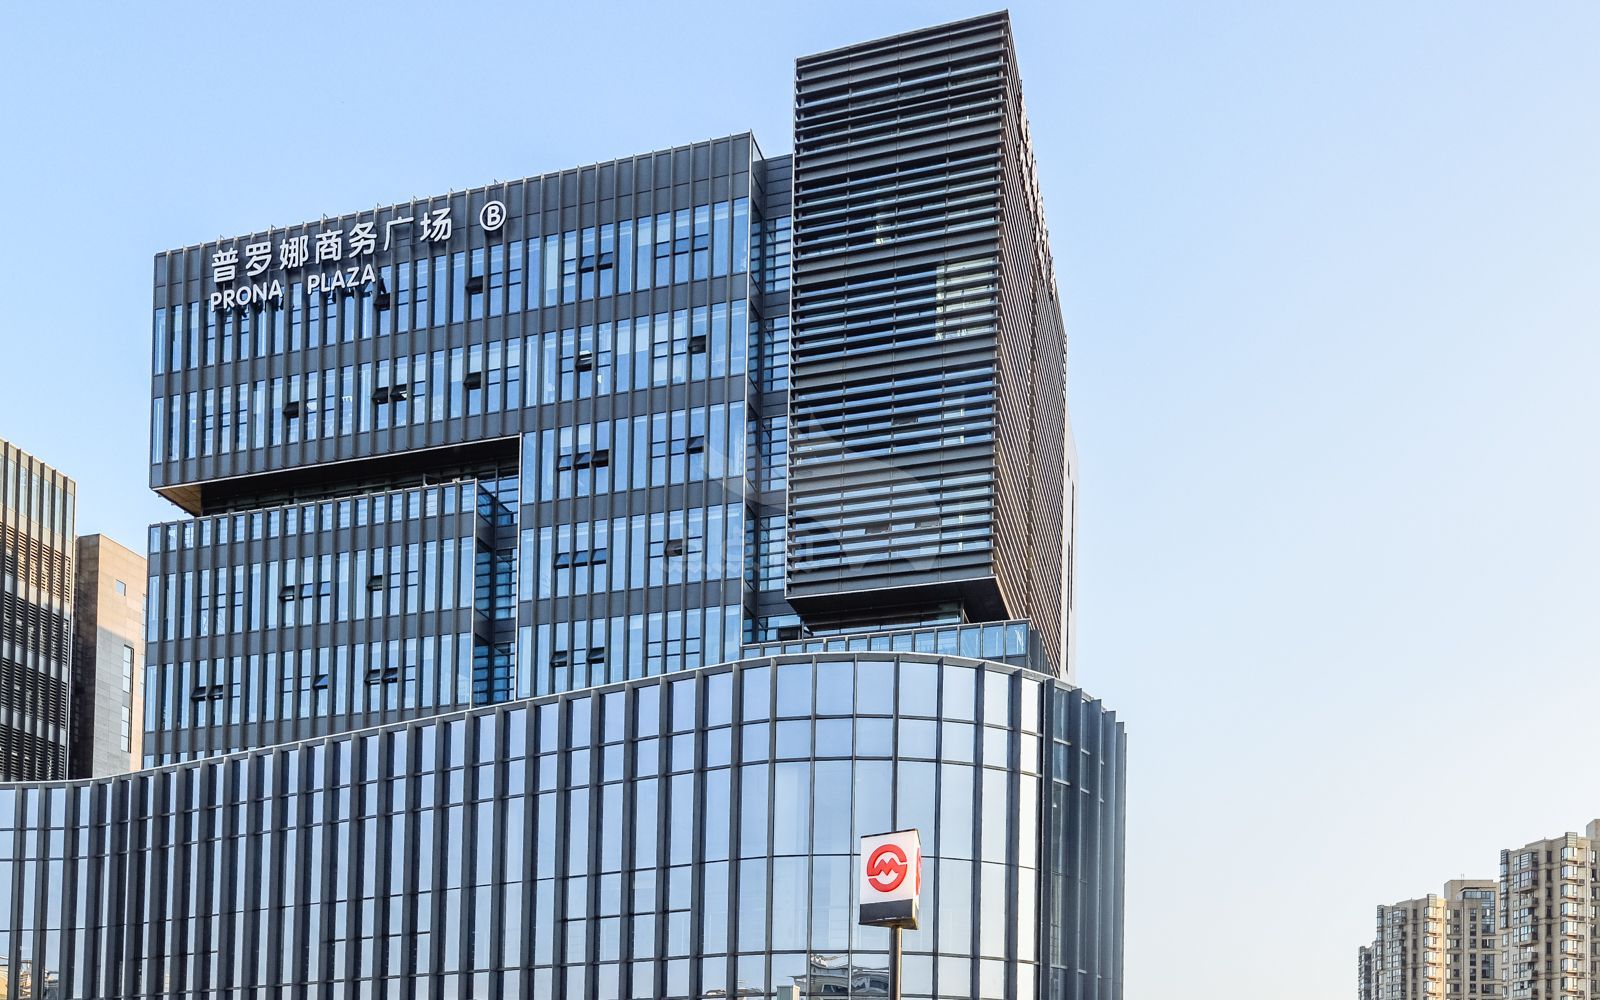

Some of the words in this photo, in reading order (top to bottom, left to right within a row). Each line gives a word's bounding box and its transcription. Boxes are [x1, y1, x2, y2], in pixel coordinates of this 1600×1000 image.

[211, 207, 452, 283] 普罗娜商务广场
[210, 279, 283, 312] PRONA
[306, 263, 376, 295] PLAZA
